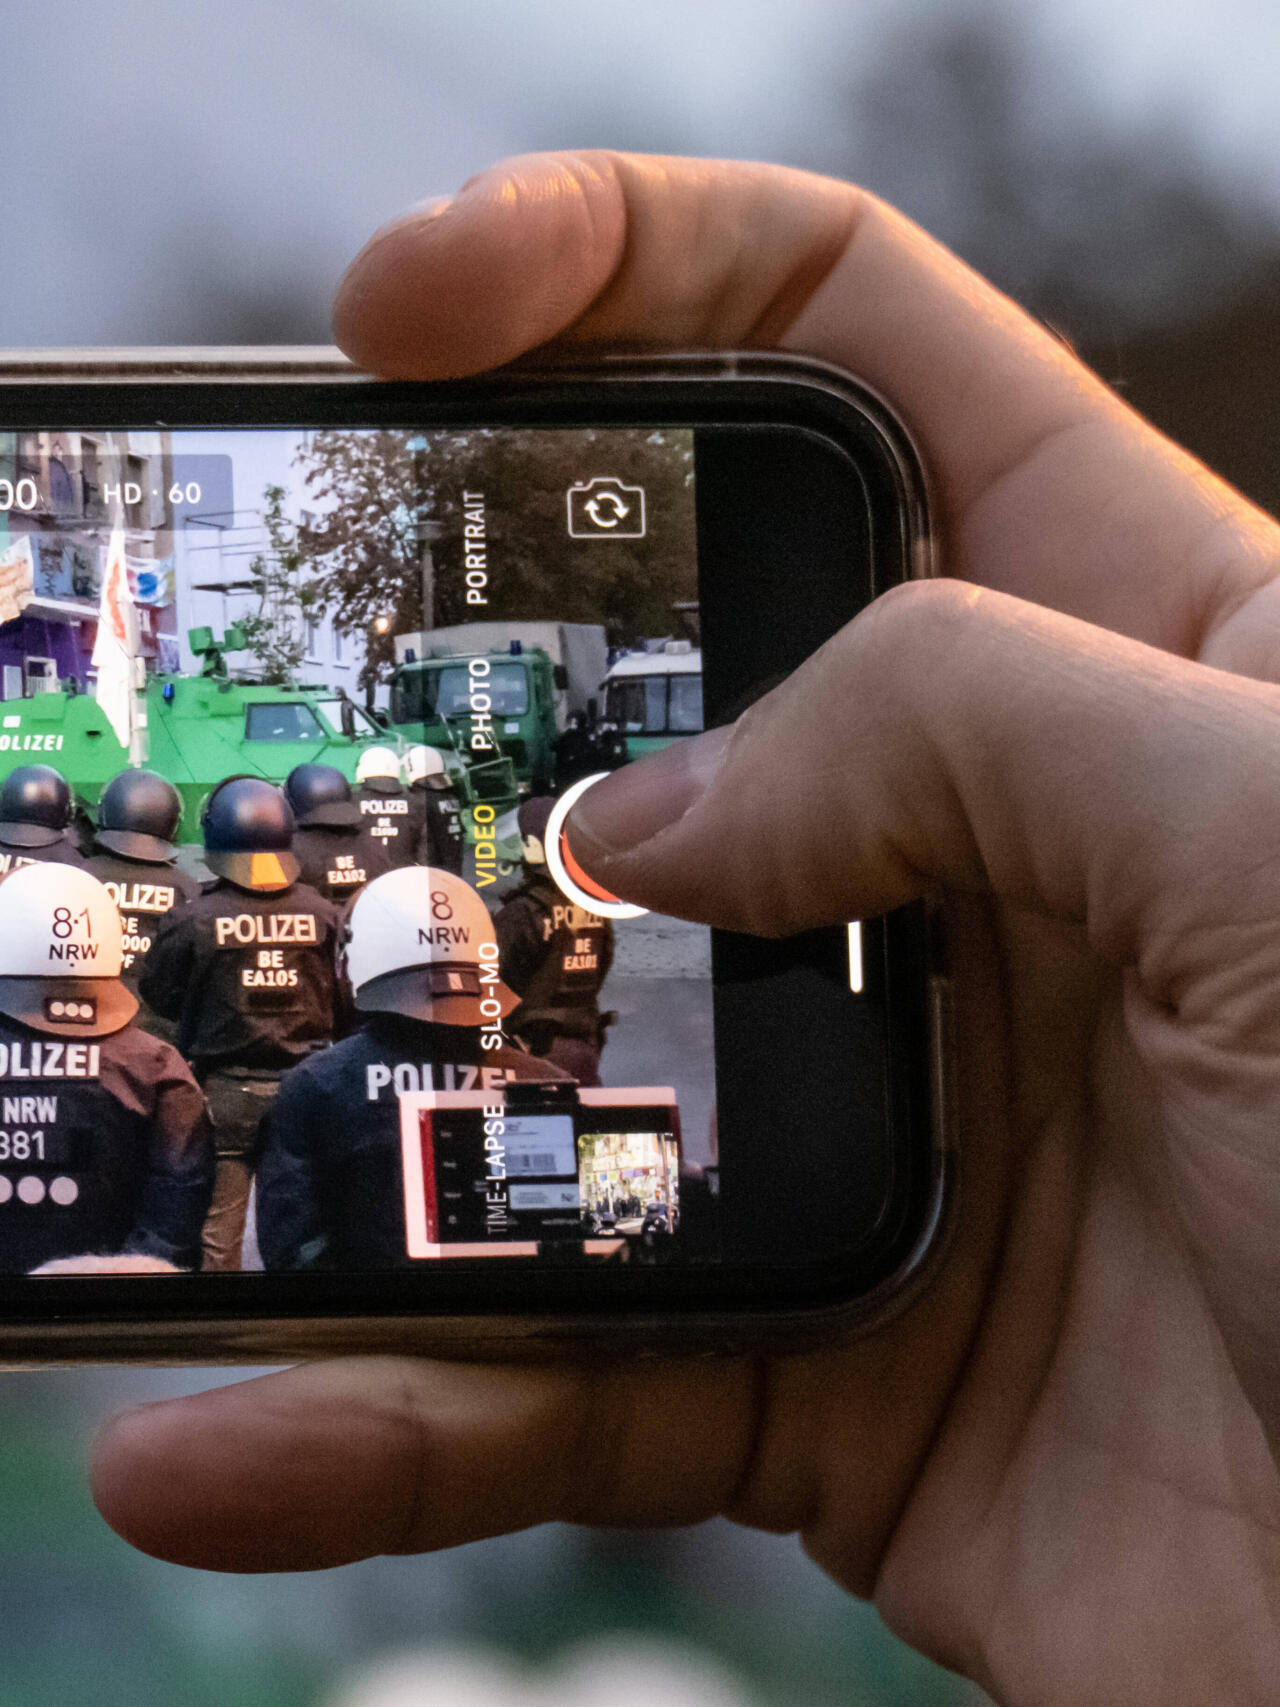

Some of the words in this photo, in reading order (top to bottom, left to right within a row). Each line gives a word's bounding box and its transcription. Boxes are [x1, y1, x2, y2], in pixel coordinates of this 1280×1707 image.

[104, 483, 142, 504] HD
[168, 483, 202, 504] 60
[464, 490, 488, 604] PORTRAIT
[469, 658, 492, 750] PHOTO
[360, 800, 408, 814] POLIZEI
[473, 804, 497, 888] VIDEO
[102, 881, 175, 912] OLIZEI
[430, 891, 453, 920] 8
[216, 914, 317, 945] POLIZEI
[418, 926, 470, 944] NRW
[49, 944, 99, 960] NRW
[258, 950, 284, 968] BE
[242, 969, 298, 987] EA105
[478, 942, 502, 1051] SLO-MO
[2, 1096, 58, 1124] NRW
[483, 1104, 508, 1236] TIME-LAPSE
